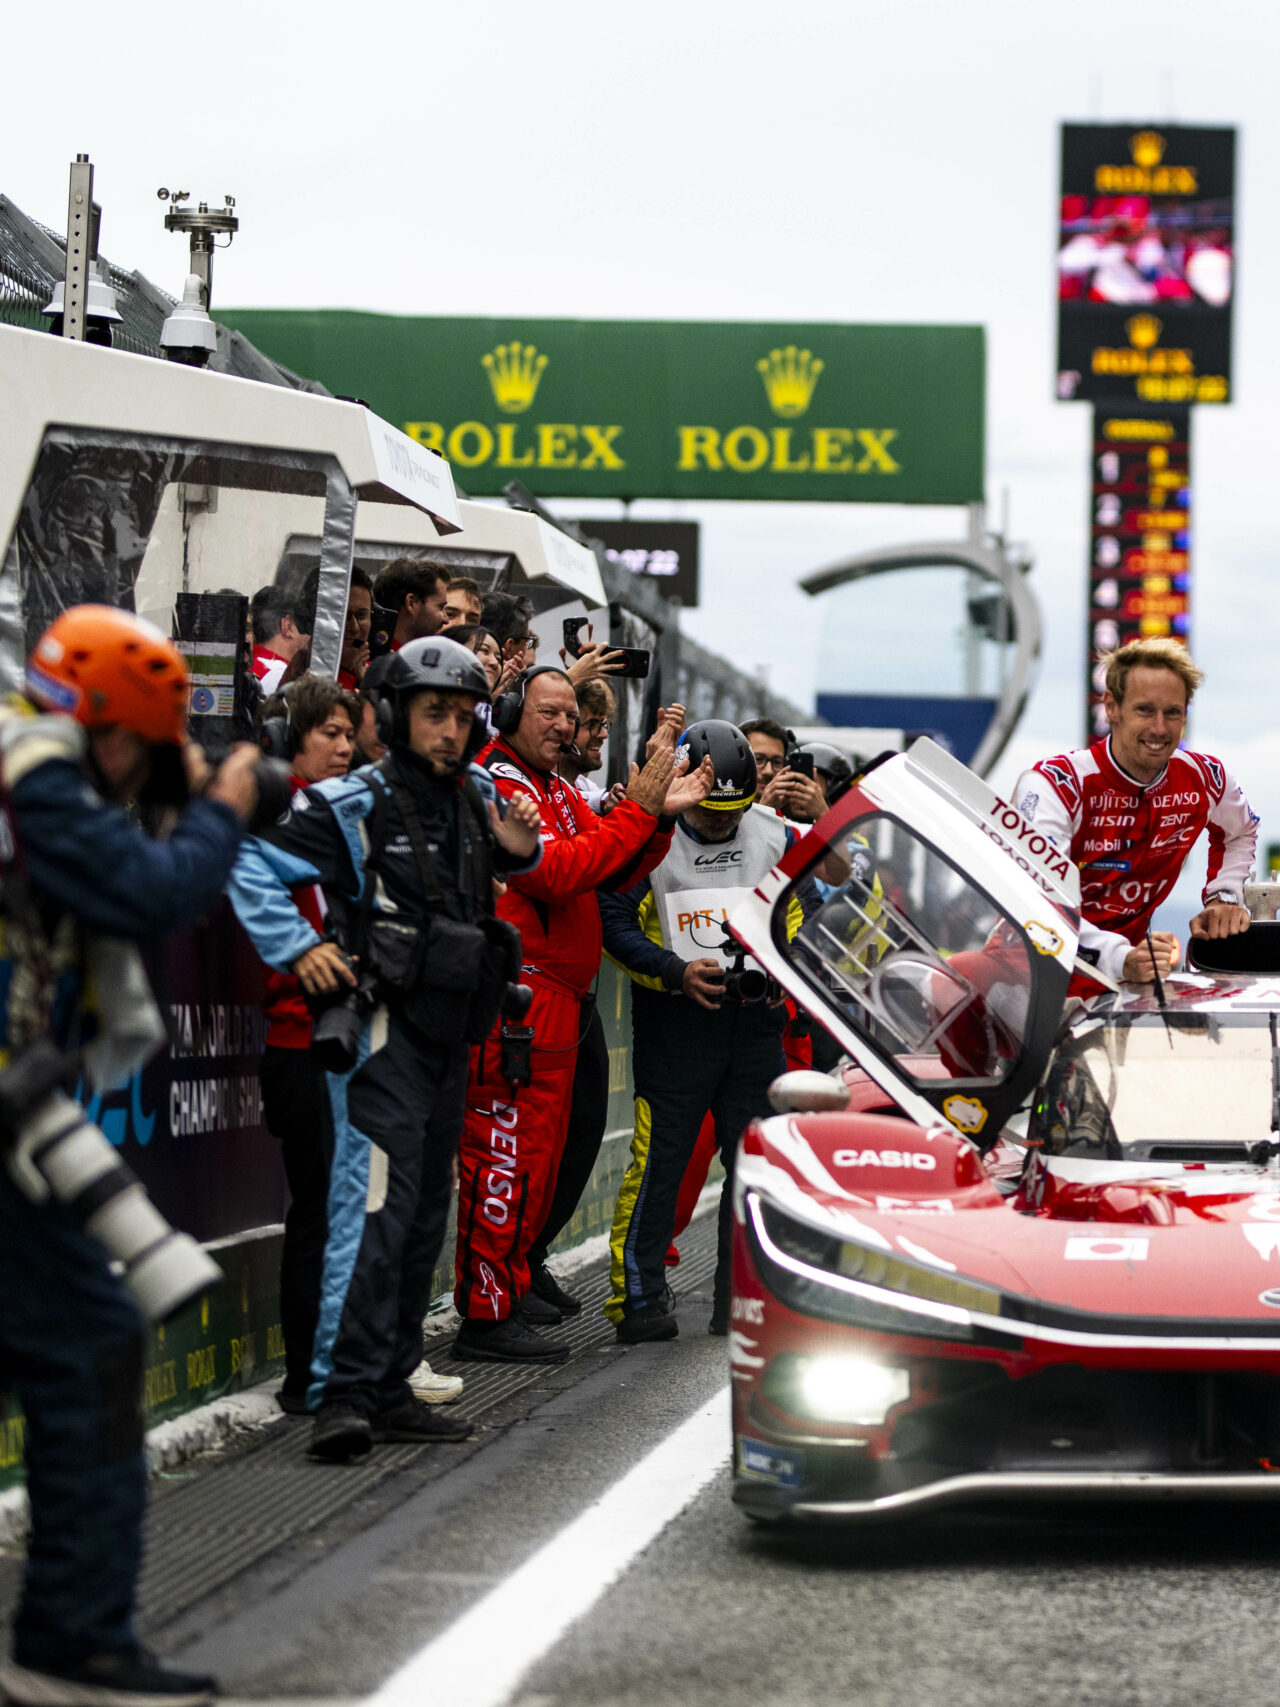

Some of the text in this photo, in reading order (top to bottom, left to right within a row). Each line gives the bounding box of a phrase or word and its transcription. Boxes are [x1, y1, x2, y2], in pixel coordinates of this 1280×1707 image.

[676, 424, 900, 473] ROLEX
[1152, 791, 1200, 808] DENSO
[1160, 812, 1191, 827] ZENT
[990, 796, 1070, 881] TOYOTA
[1083, 838, 1121, 852] Mobil
[694, 850, 743, 866] WEC
[677, 909, 714, 932] PIT
[483, 1099, 518, 1225] DENSO
[832, 1149, 937, 1171] CASIO
